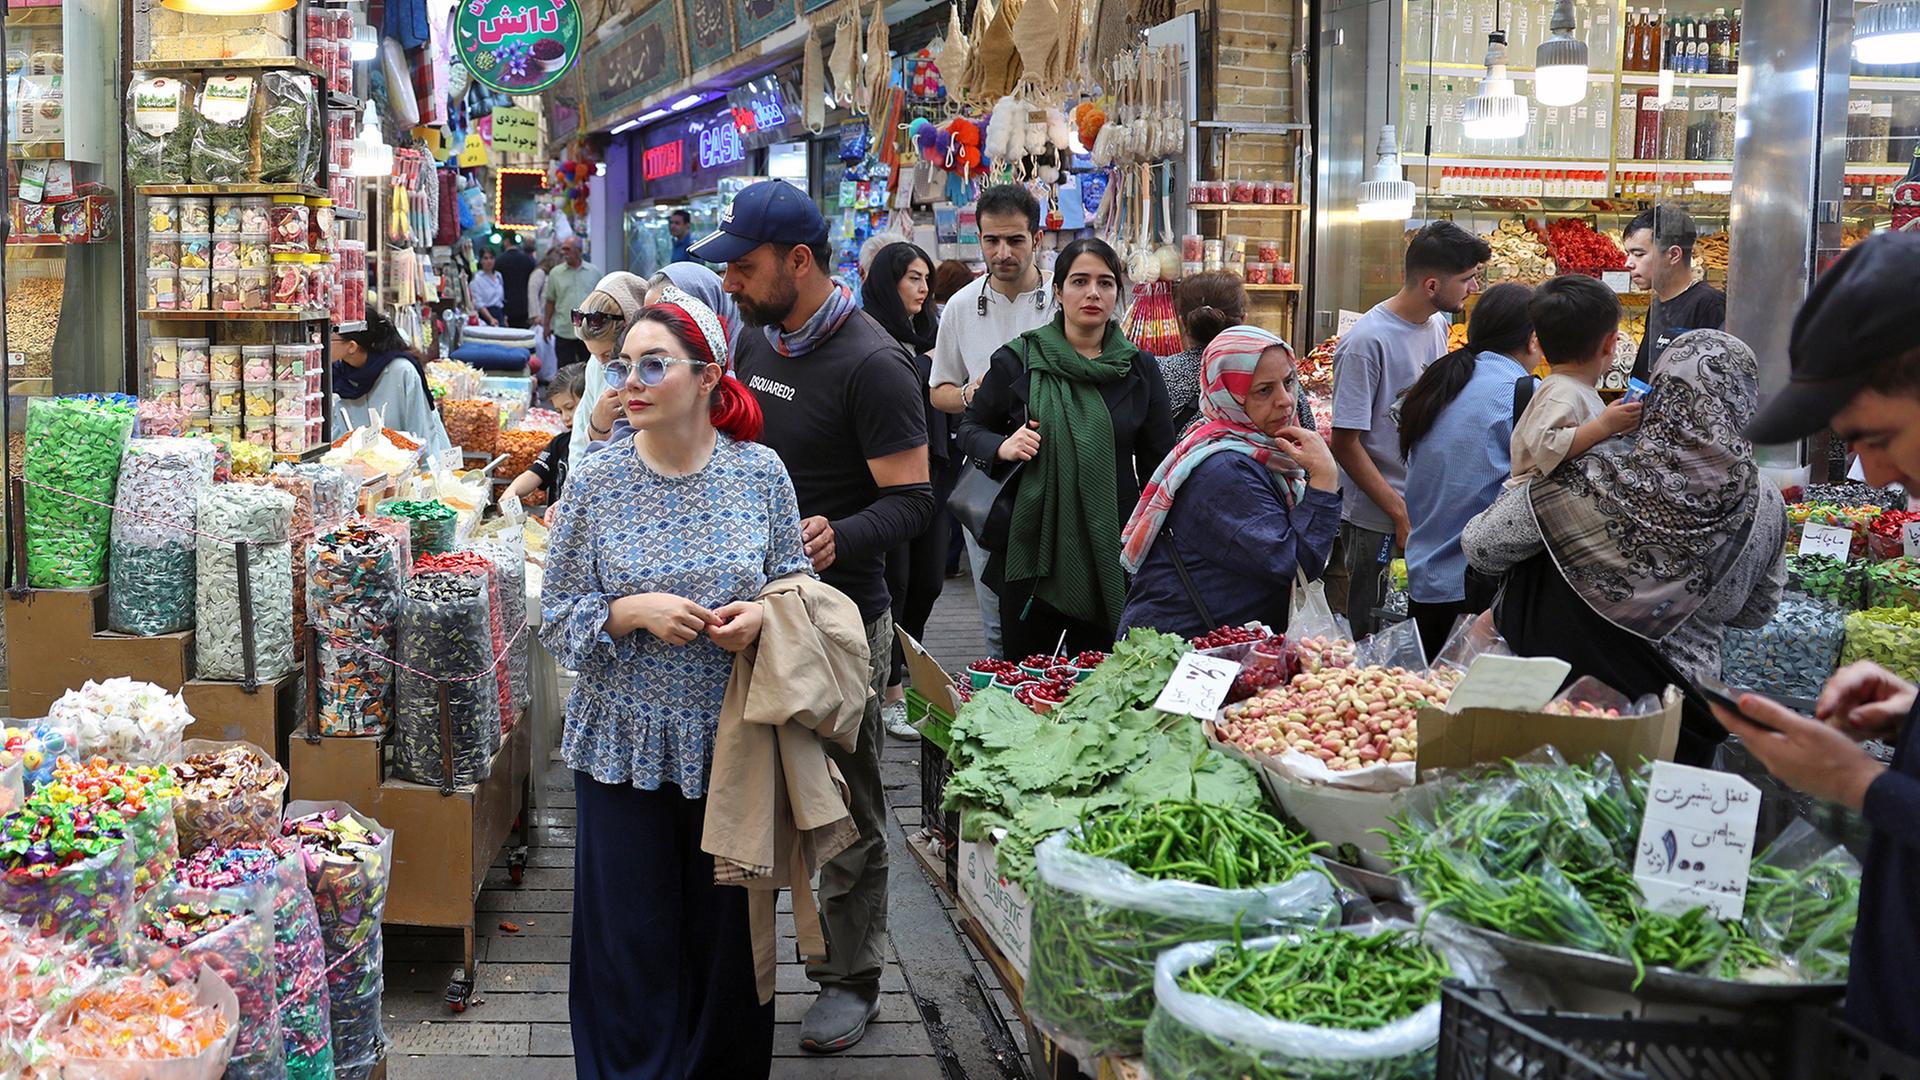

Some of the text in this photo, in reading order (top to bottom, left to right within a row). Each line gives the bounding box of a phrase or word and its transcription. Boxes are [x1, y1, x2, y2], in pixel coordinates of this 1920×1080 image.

[478, 5, 558, 44] دانش
[493, 133, 537, 150] موجود است
[1655, 783, 1749, 814] فلفل شیرین
